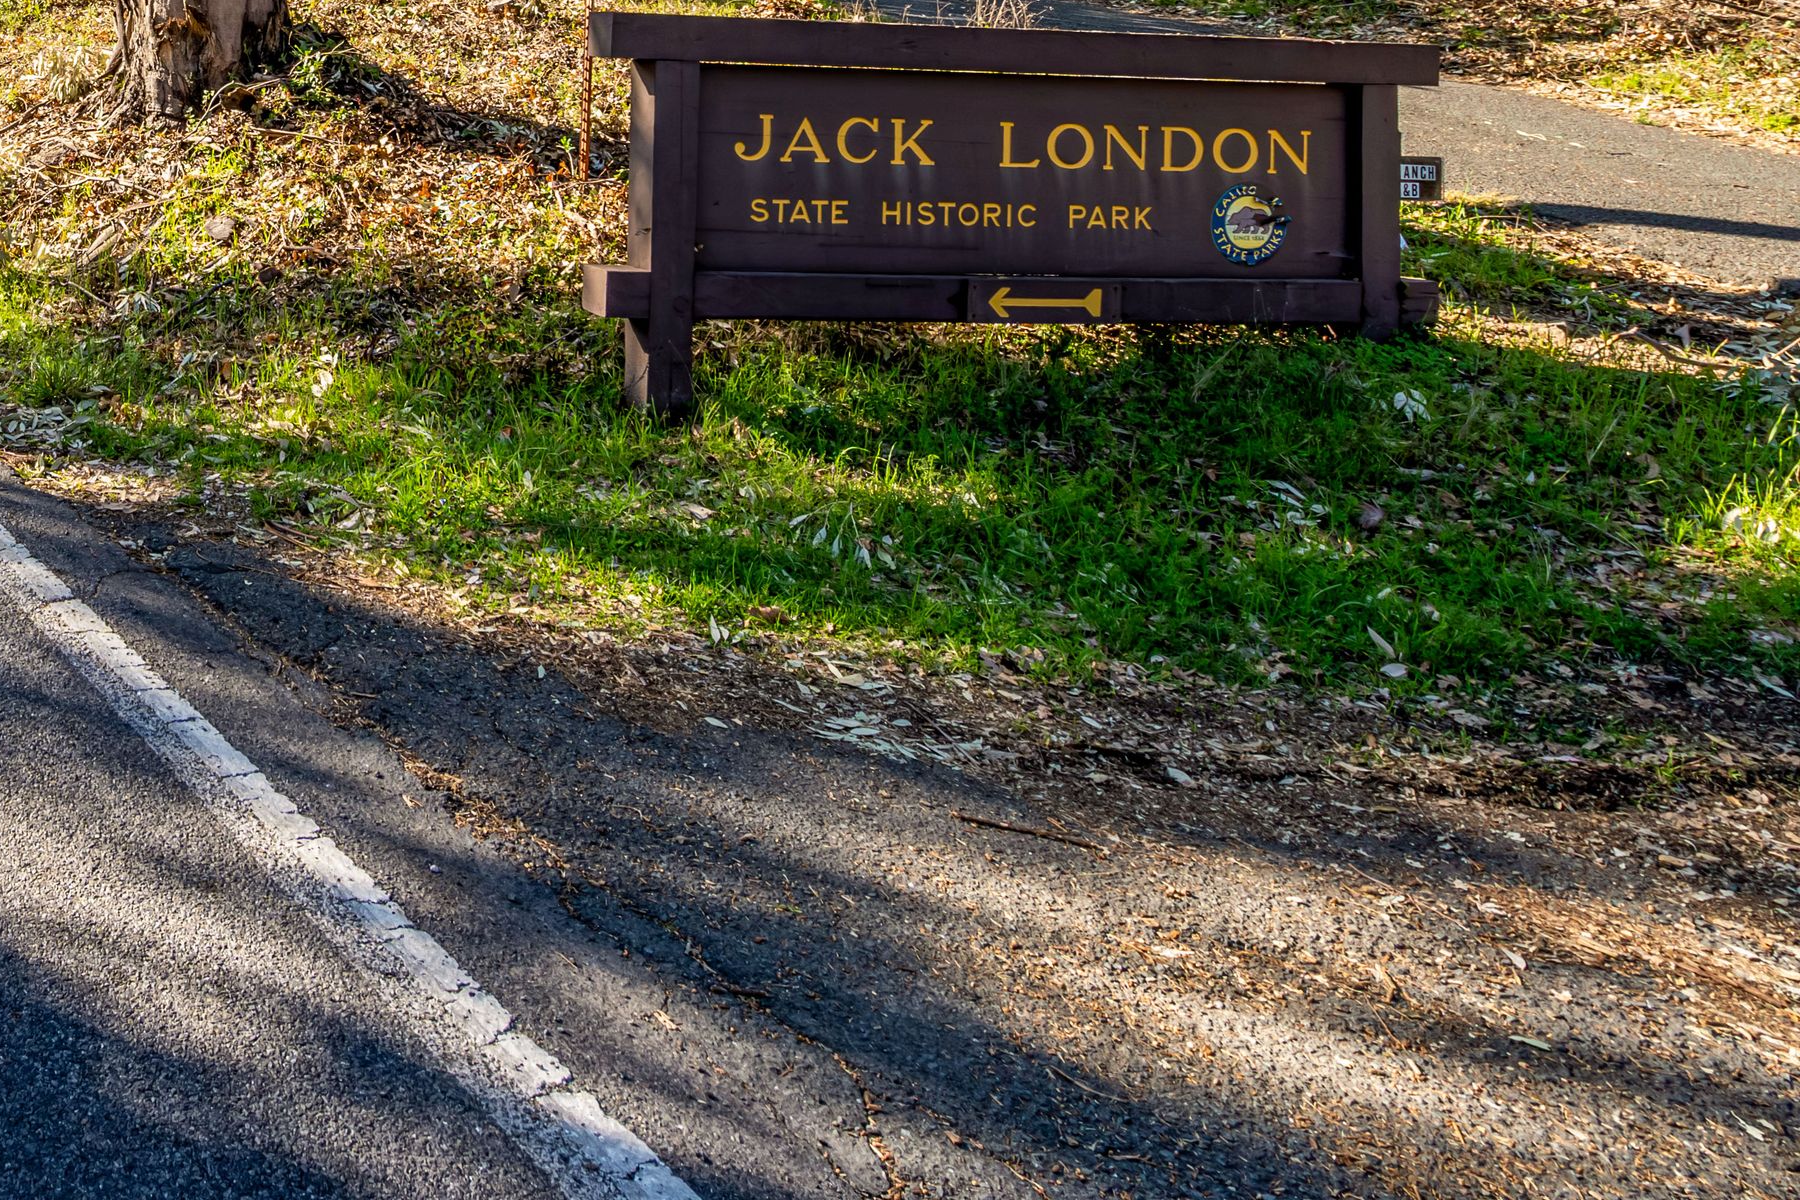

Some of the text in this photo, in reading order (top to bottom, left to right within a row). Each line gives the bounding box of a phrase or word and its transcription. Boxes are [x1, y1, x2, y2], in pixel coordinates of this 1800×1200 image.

[734, 113, 1312, 176] JACK LONDON
[1403, 166, 1435, 180] ANCH
[1403, 183, 1418, 197] &B
[750, 198, 1152, 230] STATE HISTORIC PARK
[1214, 227, 1283, 261] STATE PARKS
